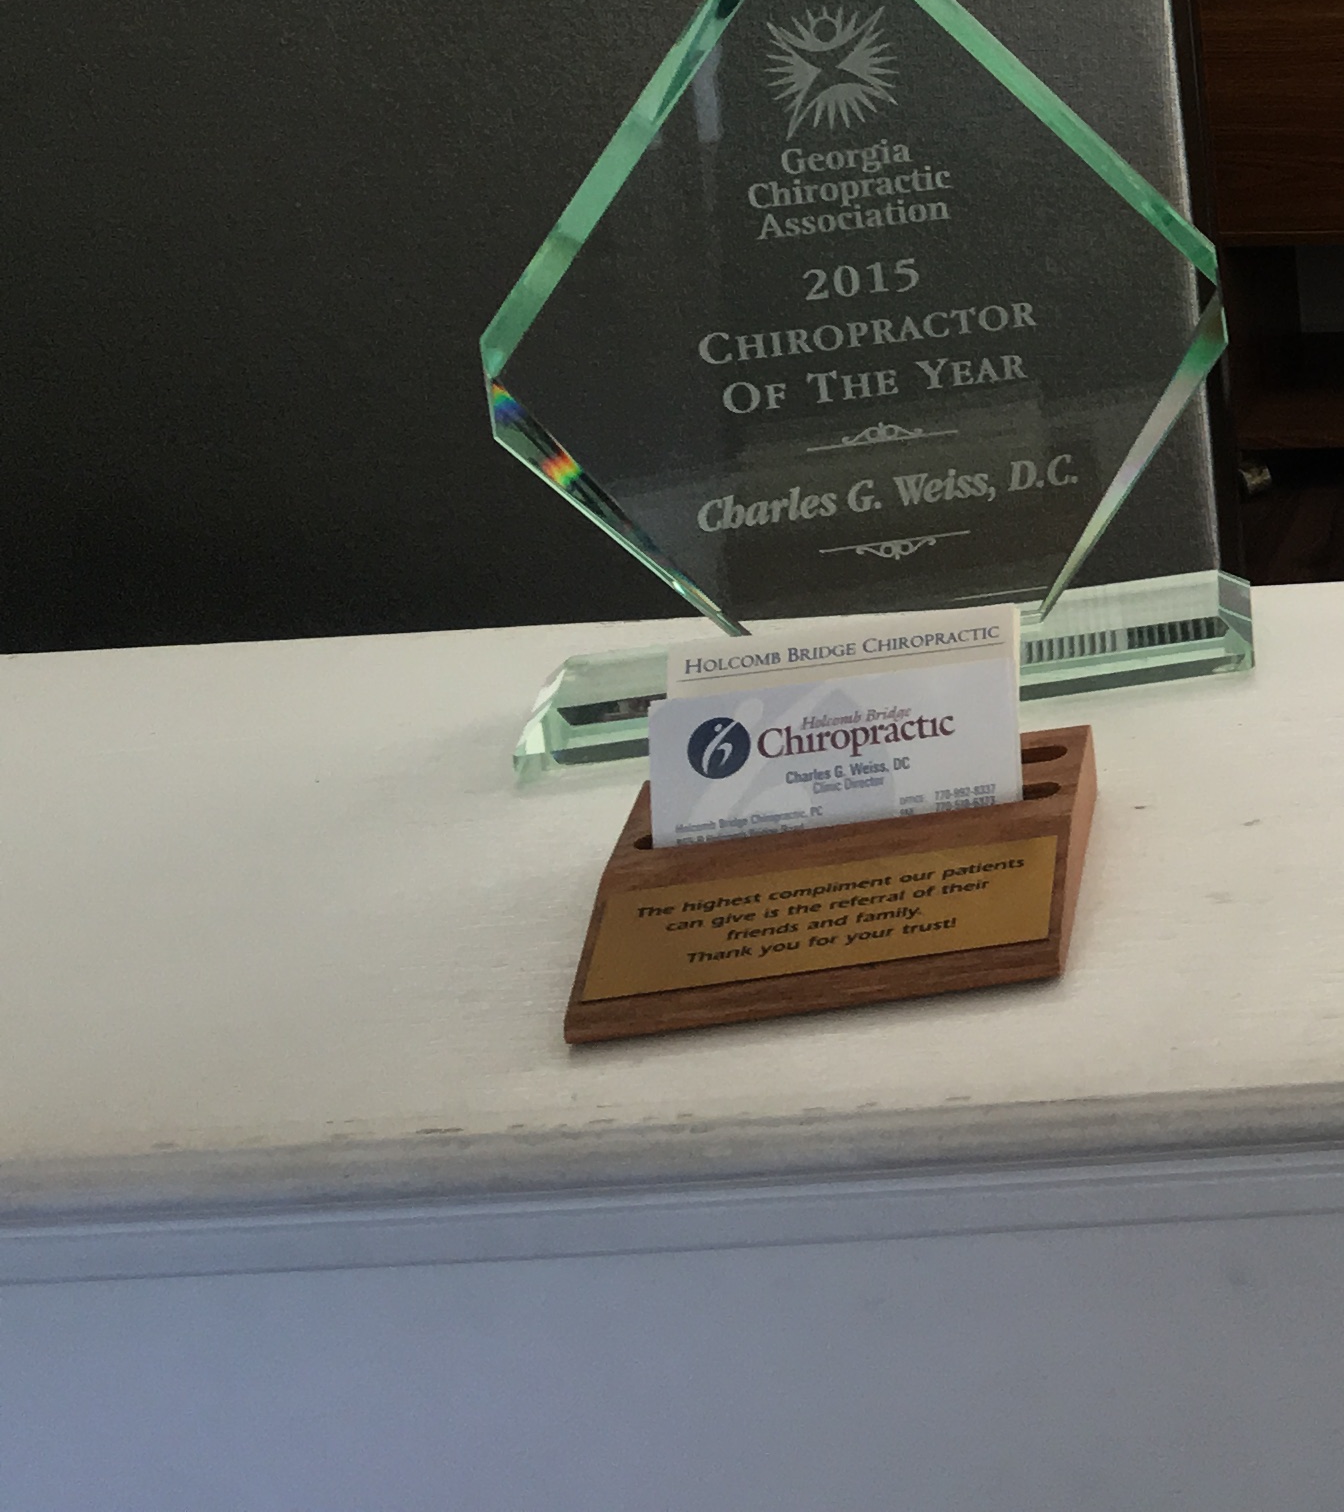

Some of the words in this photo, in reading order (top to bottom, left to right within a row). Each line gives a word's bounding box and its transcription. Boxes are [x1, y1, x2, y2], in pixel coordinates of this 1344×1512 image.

[781, 139, 912, 175] Georgia
[747, 165, 954, 210] Chiropractic
[756, 198, 951, 241] Association
[802, 258, 920, 301] 2015
[699, 302, 1038, 366] CHIROPRACTOR
[697, 486, 837, 533] Charles
[846, 479, 882, 513] G.
[893, 468, 997, 506] Weiss,
[1008, 454, 1079, 492] D.C.
[684, 651, 782, 676] HOLCOMB
[787, 642, 858, 664] BRIDGE
[862, 625, 1001, 654] CHIROPRACTIC
[757, 715, 956, 759] Chiropractic
[801, 713, 862, 731] Holcomb
[865, 705, 912, 723] Bridge
[785, 769, 832, 785] Charles
[834, 765, 847, 778] G.
[849, 761, 890, 777] Weiss,
[893, 757, 911, 771] DC
[812, 780, 843, 795] Clinic
[844, 776, 885, 791] Director
[810, 805, 824, 817] PC
[637, 906, 675, 918] The
[682, 893, 761, 913] highest
[768, 876, 892, 900] compliment
[900, 871, 936, 883] our
[941, 858, 1025, 881] patients
[665, 918, 704, 932] can
[711, 912, 757, 929] give
[763, 908, 779, 919] is
[787, 902, 822, 916] the
[829, 890, 905, 910] referral
[912, 885, 936, 899] of
[941, 879, 989, 895] their
[686, 945, 753, 963] Thank
[757, 940, 800, 958] you
[808, 934, 837, 948] for
[844, 926, 894, 946] your
[902, 917, 957, 935] trust!
[726, 922, 799, 942] friends
[807, 914, 848, 930] and
[855, 906, 923, 924] family.
